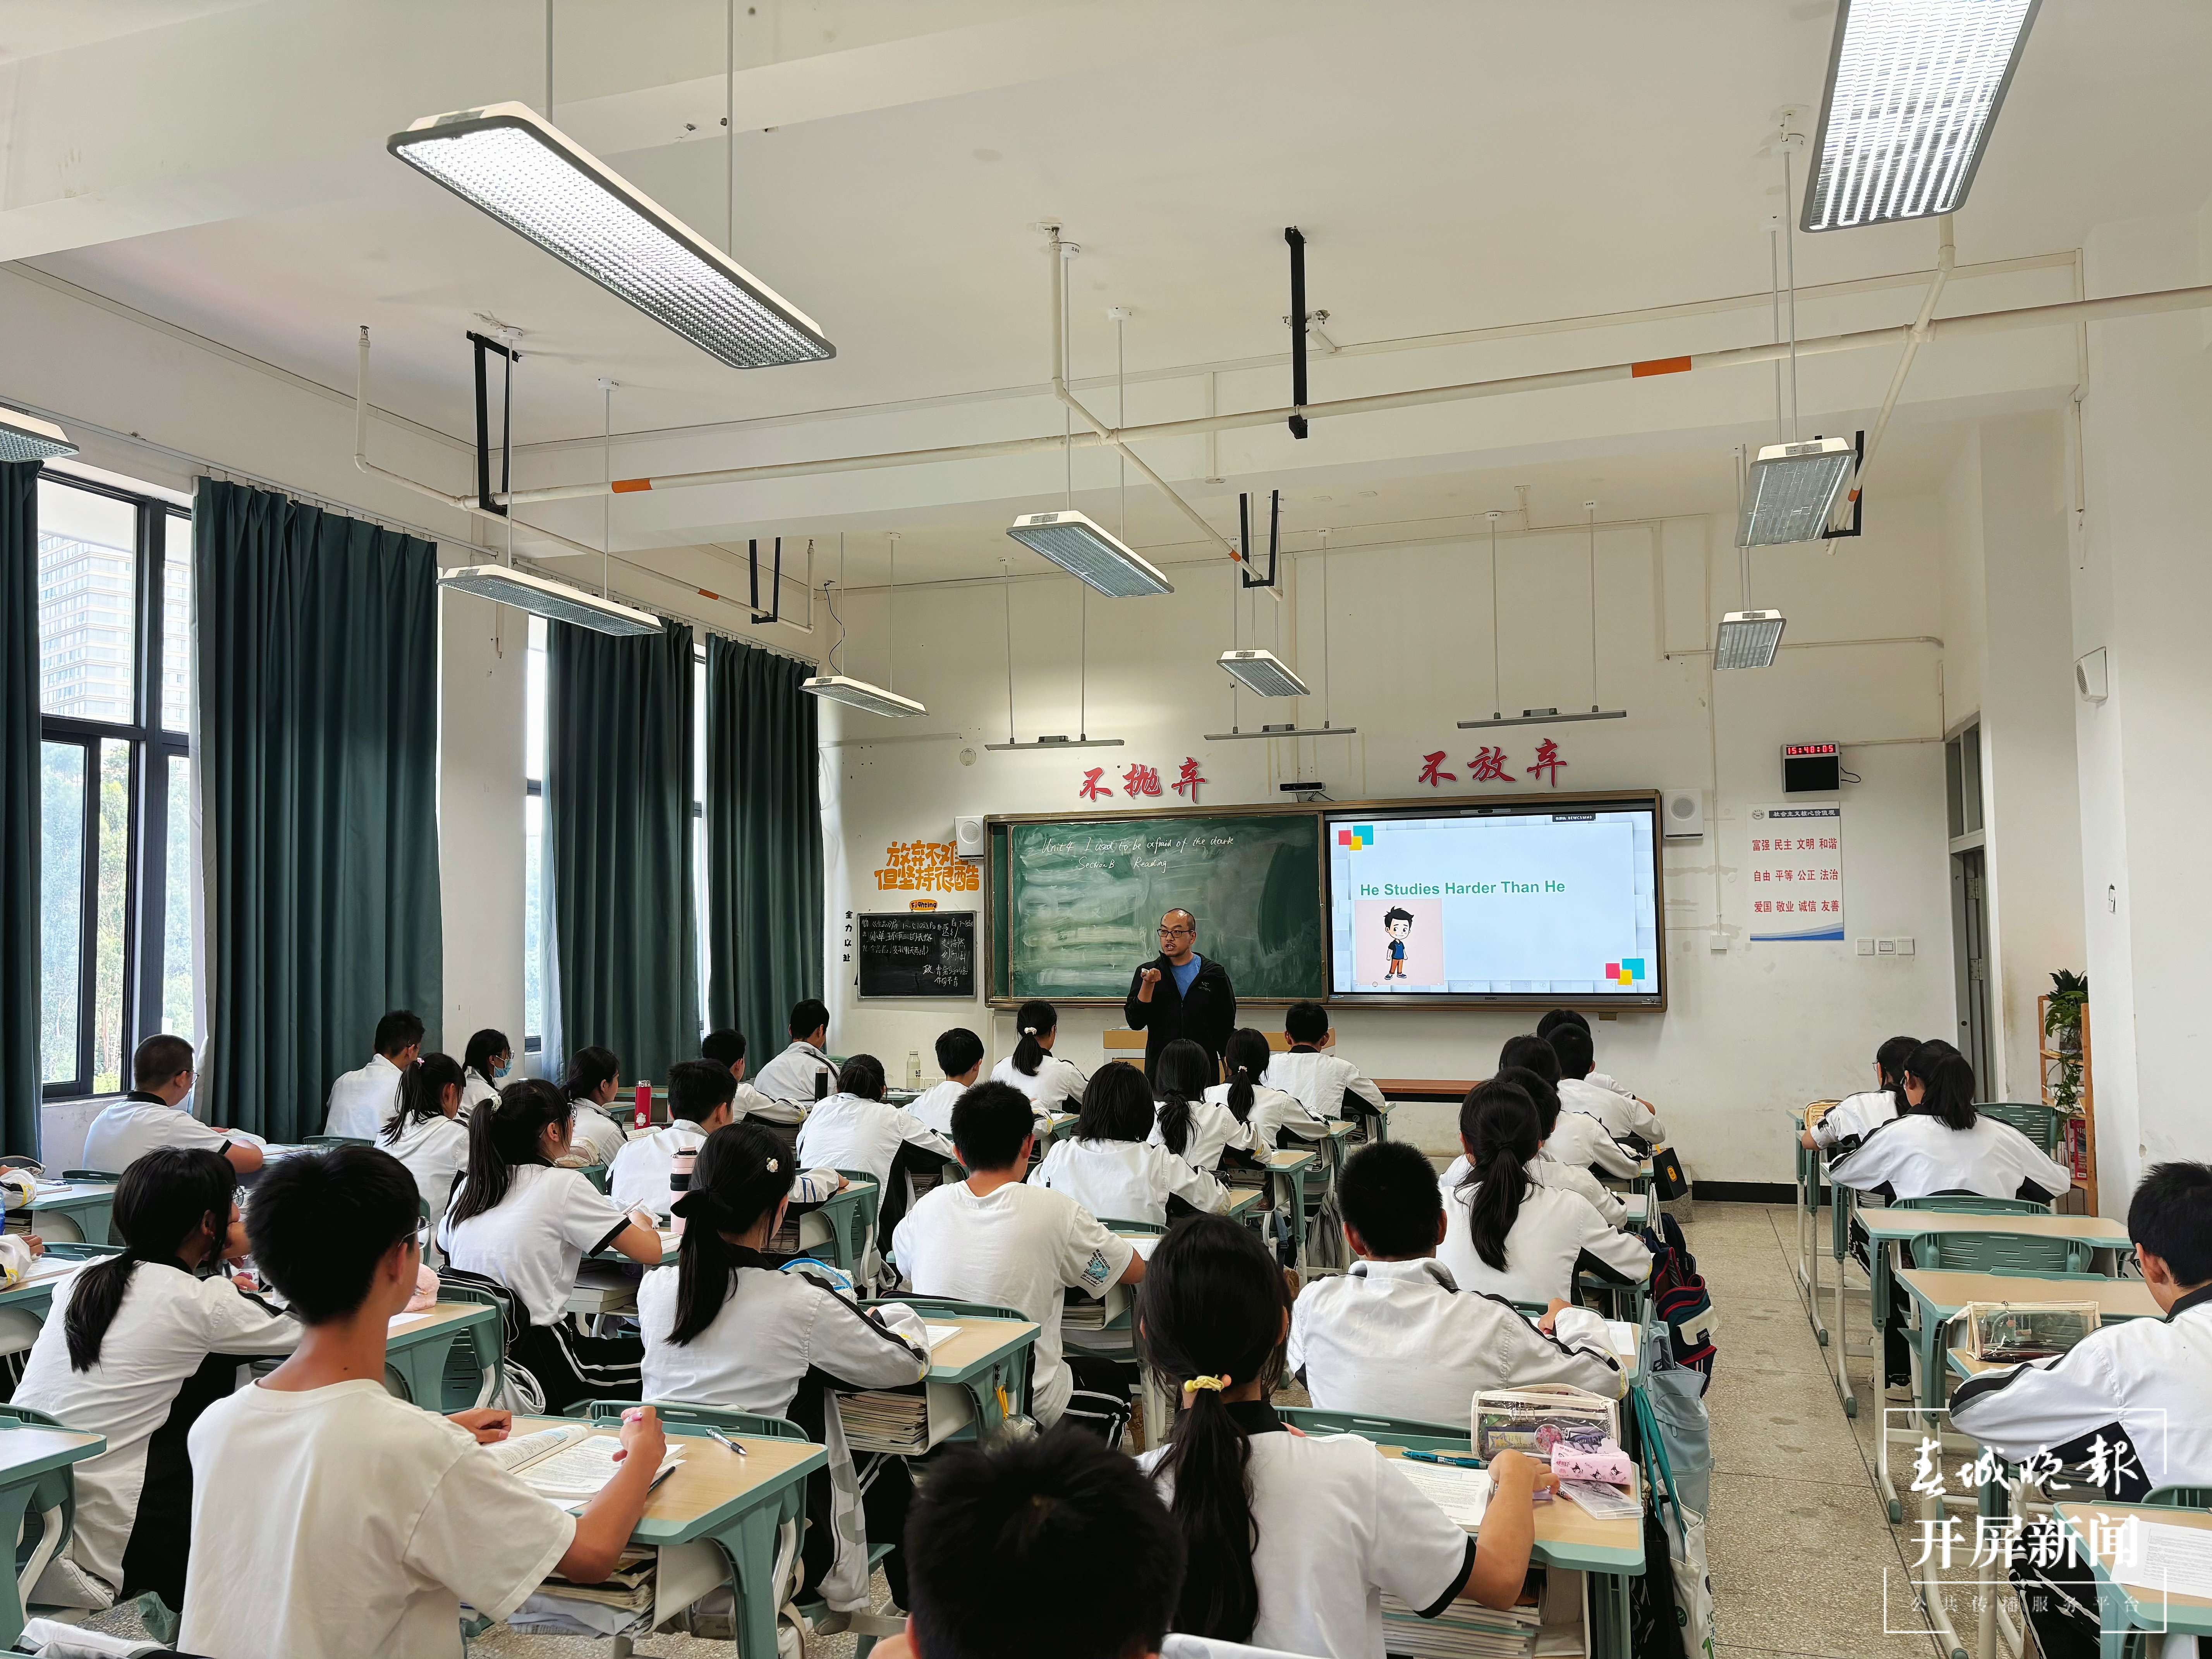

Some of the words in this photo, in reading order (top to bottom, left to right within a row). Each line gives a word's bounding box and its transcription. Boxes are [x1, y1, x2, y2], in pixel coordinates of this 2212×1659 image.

[1788, 745, 1833, 754] 15:48:05
[1418, 738, 1568, 788] 不放弃
[1079, 757, 1207, 803] 不抛弃
[1084, 837, 1092, 851] I
[1095, 841, 1113, 851] used
[1119, 841, 1128, 851] to
[1132, 838, 1141, 850] be
[1147, 837, 1172, 854] afraid
[1176, 838, 1188, 854] of
[1192, 837, 1206, 846] the
[1210, 836, 1233, 845] dark
[1752, 839, 1770, 851] 富强
[1774, 839, 1792, 850] 民主
[1796, 838, 1814, 850] 文明
[1819, 838, 1838, 850] 和谐
[1133, 856, 1167, 874] Reading
[874, 864, 980, 893] 但坚持很酷
[1754, 870, 1771, 882] 自由
[1775, 869, 1793, 881] 平等
[1797, 869, 1816, 881] 公正
[1820, 869, 1838, 880] 法治
[1360, 884, 1379, 896] He
[1384, 883, 1440, 895] Studies
[1445, 882, 1496, 894] Harder
[1501, 881, 1539, 893] Than
[1545, 880, 1565, 893] He
[1754, 901, 1772, 913] 爱国
[1776, 901, 1794, 912] 敬业
[1798, 900, 1817, 912] 诚信
[1821, 900, 1839, 912] 友善
[843, 910, 853, 962] 全力以赴
